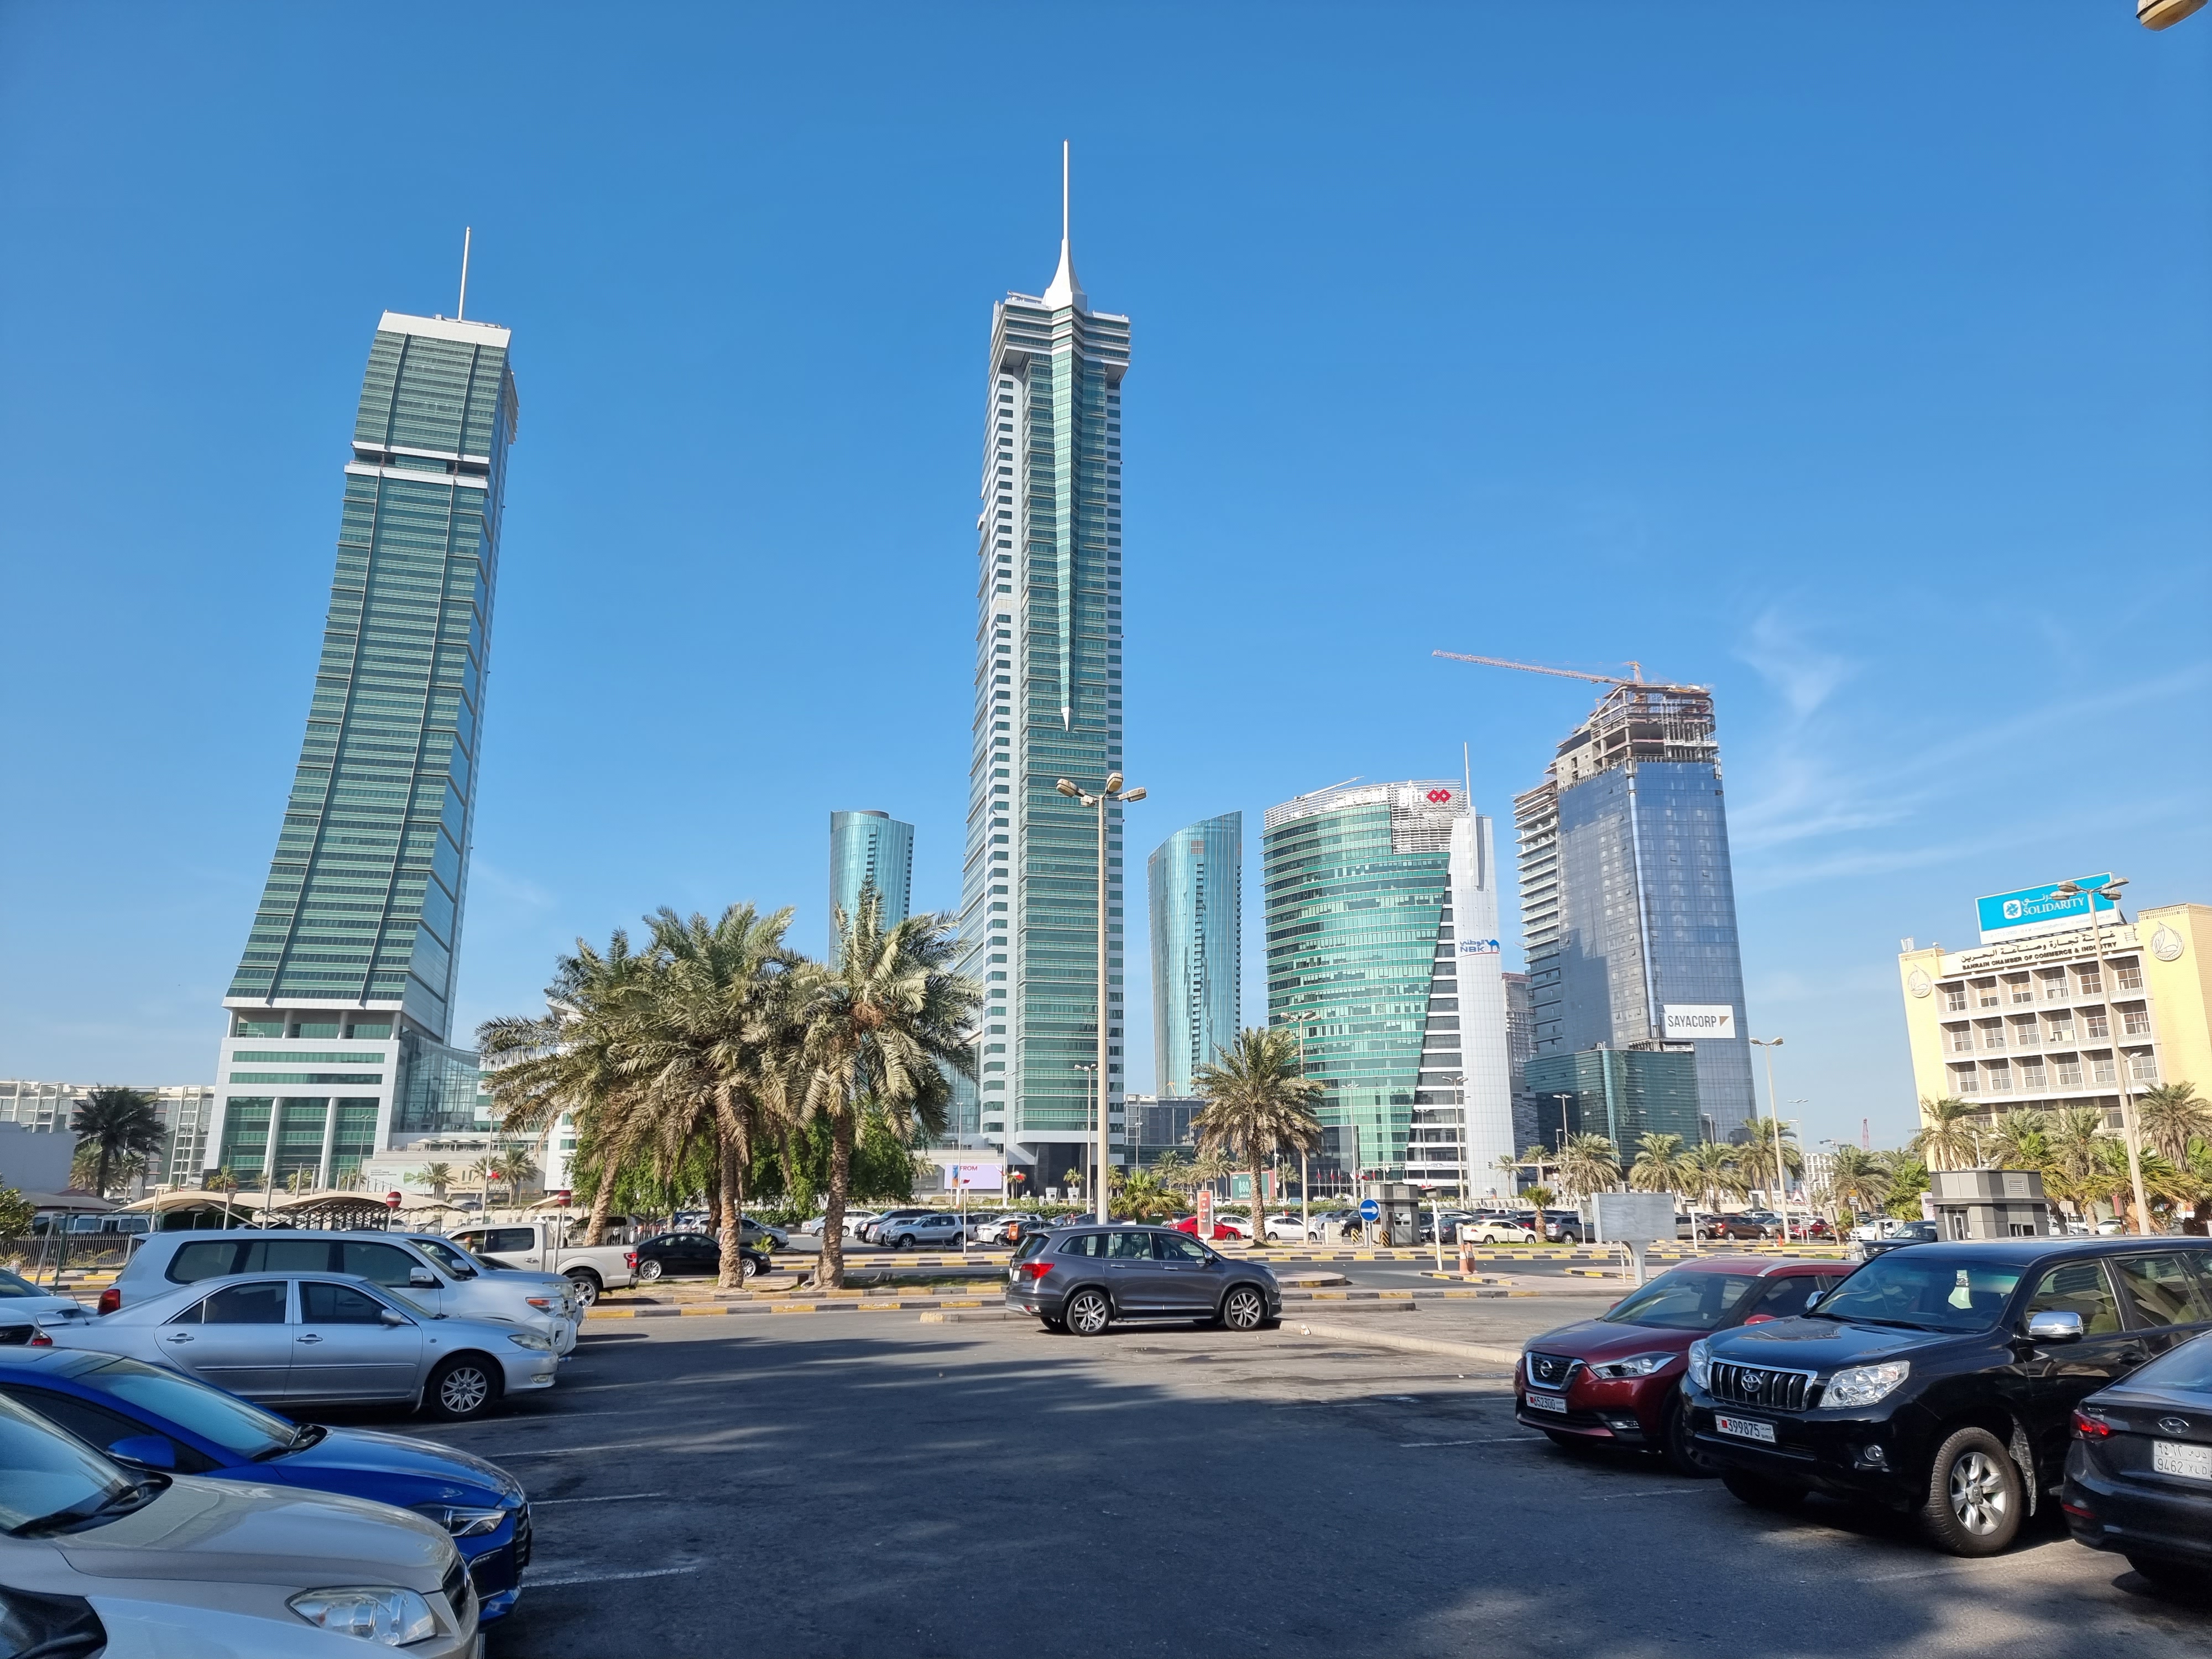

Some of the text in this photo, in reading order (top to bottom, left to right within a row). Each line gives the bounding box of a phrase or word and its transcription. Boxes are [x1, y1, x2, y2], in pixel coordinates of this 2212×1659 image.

[2023, 897, 2084, 916] SOLIDARITY
[2000, 945, 2047, 954] وصناعة
[2049, 936, 2079, 948] تجارة
[1961, 949, 1997, 963] البحرين
[1962, 961, 1990, 971] BAHRAIN
[1991, 956, 2023, 966] CHAMBER
[2034, 948, 2073, 959] COMMERCE
[1668, 1015, 1717, 1028] SAYACORP
[1726, 1419, 1760, 1437] 399875
[2157, 1458, 2184, 1474] 9462
